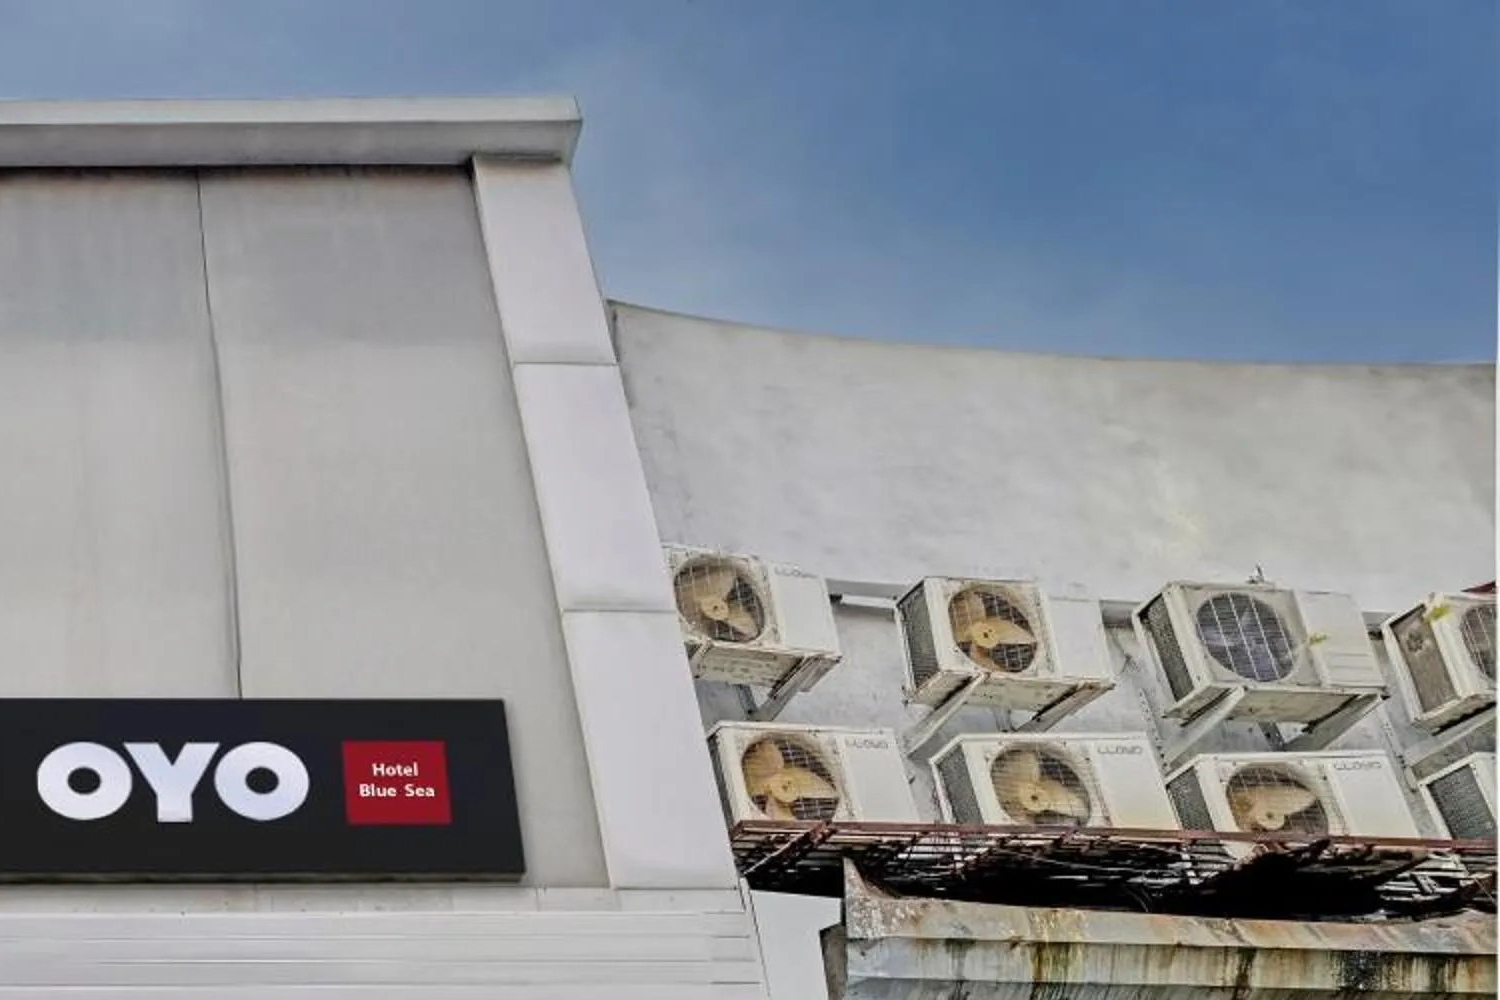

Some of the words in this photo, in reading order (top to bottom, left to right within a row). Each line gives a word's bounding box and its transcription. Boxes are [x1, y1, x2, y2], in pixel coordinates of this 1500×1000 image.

[372, 762, 419, 777] Hotel
[36, 741, 310, 822] OYO
[359, 783, 397, 797] Blue
[404, 783, 435, 797] Sea
